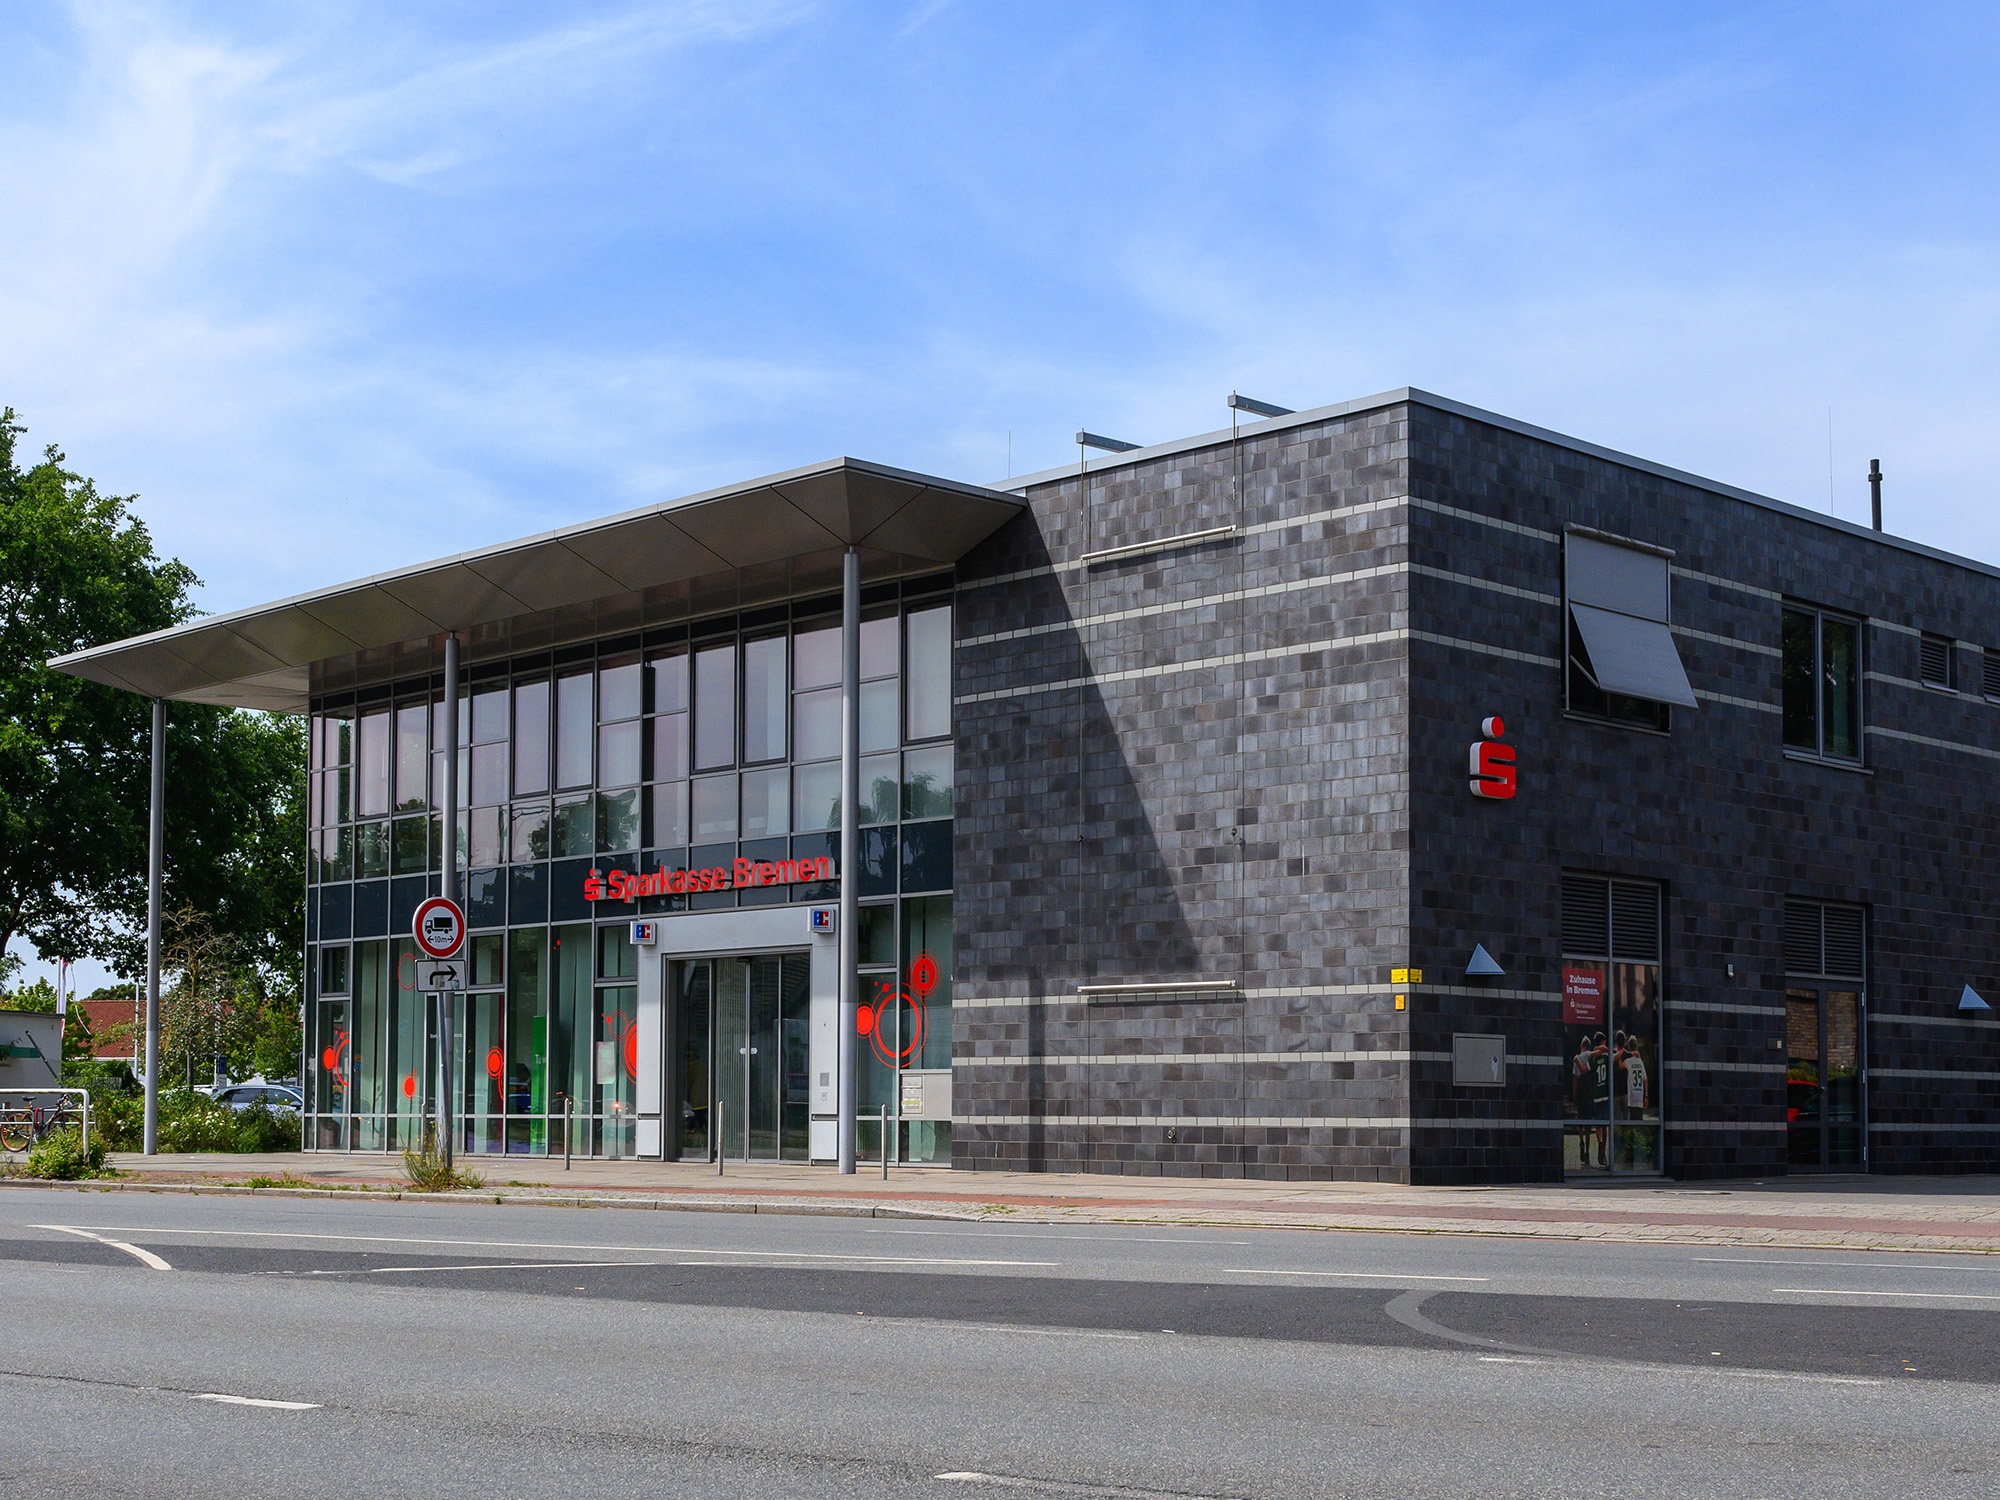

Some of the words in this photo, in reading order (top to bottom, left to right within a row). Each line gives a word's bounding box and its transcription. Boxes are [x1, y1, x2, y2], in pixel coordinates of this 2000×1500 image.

[608, 865, 730, 904] Sparkasse
[733, 856, 831, 888] Bremen
[1569, 975, 1596, 985] Zuhause
[1574, 986, 1600, 996] Bremen.
[1596, 1064, 1607, 1083] 10
[1632, 1070, 1643, 1088] 35
